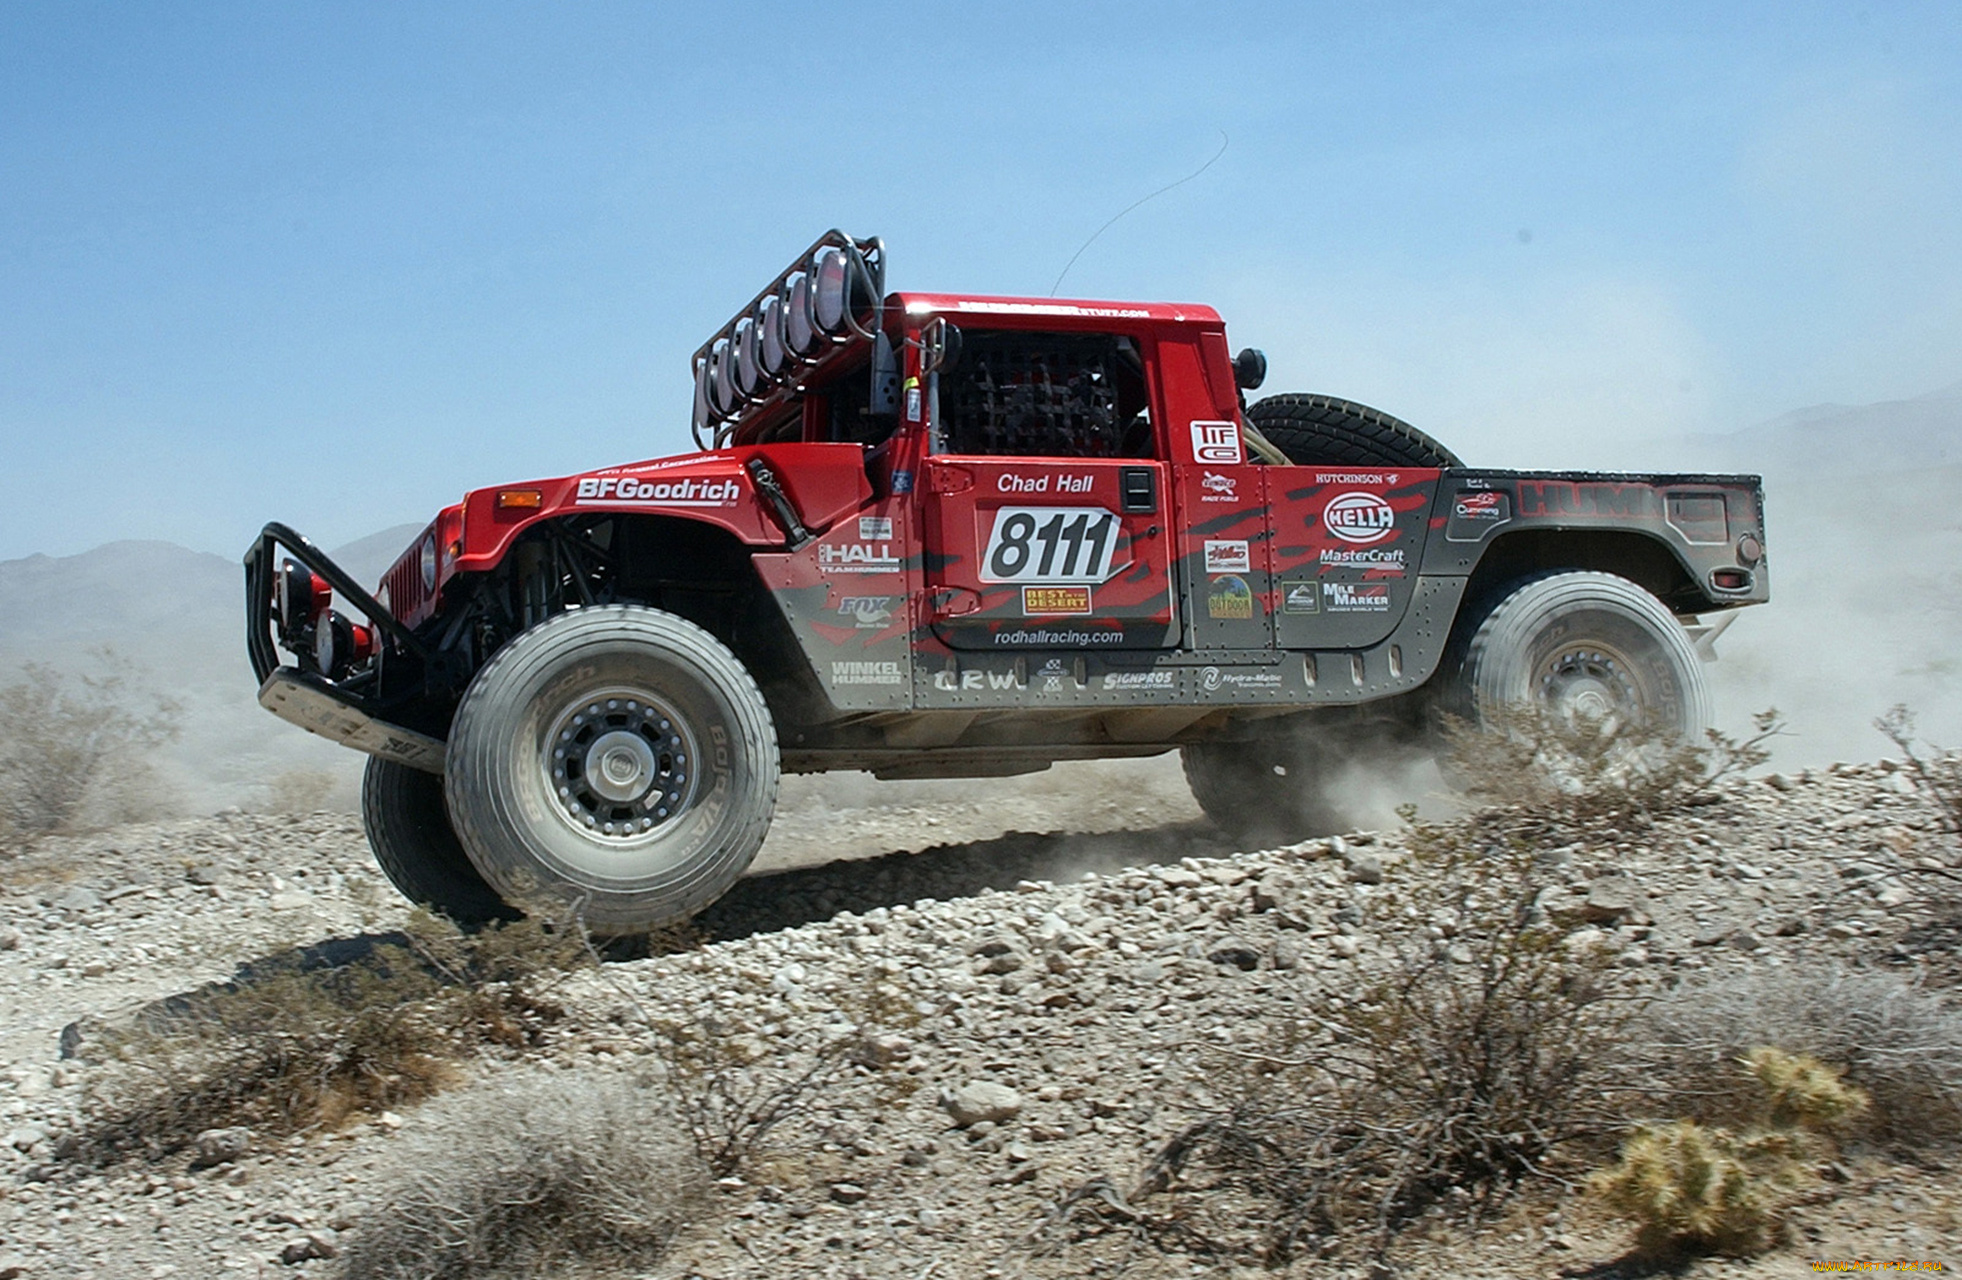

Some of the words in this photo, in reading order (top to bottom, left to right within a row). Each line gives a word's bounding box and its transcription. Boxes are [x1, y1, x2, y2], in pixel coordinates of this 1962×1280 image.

[997, 473, 1049, 492] Chad
[1056, 474, 1094, 492] Hall
[1315, 473, 1383, 484] HUTCHINSON
[577, 478, 740, 500] BFGoodrich
[1328, 506, 1393, 528] HELLA
[826, 544, 900, 563] HALL
[991, 512, 1113, 578] 8111
[1320, 549, 1405, 562] MasterCraft
[1026, 590, 1066, 598] BEST
[1027, 598, 1087, 607] DESERT
[838, 597, 891, 615] FOX
[995, 629, 1124, 646] rodhallracing.com
[831, 661, 901, 675] WINKEL
[832, 675, 902, 684] HUMMER
